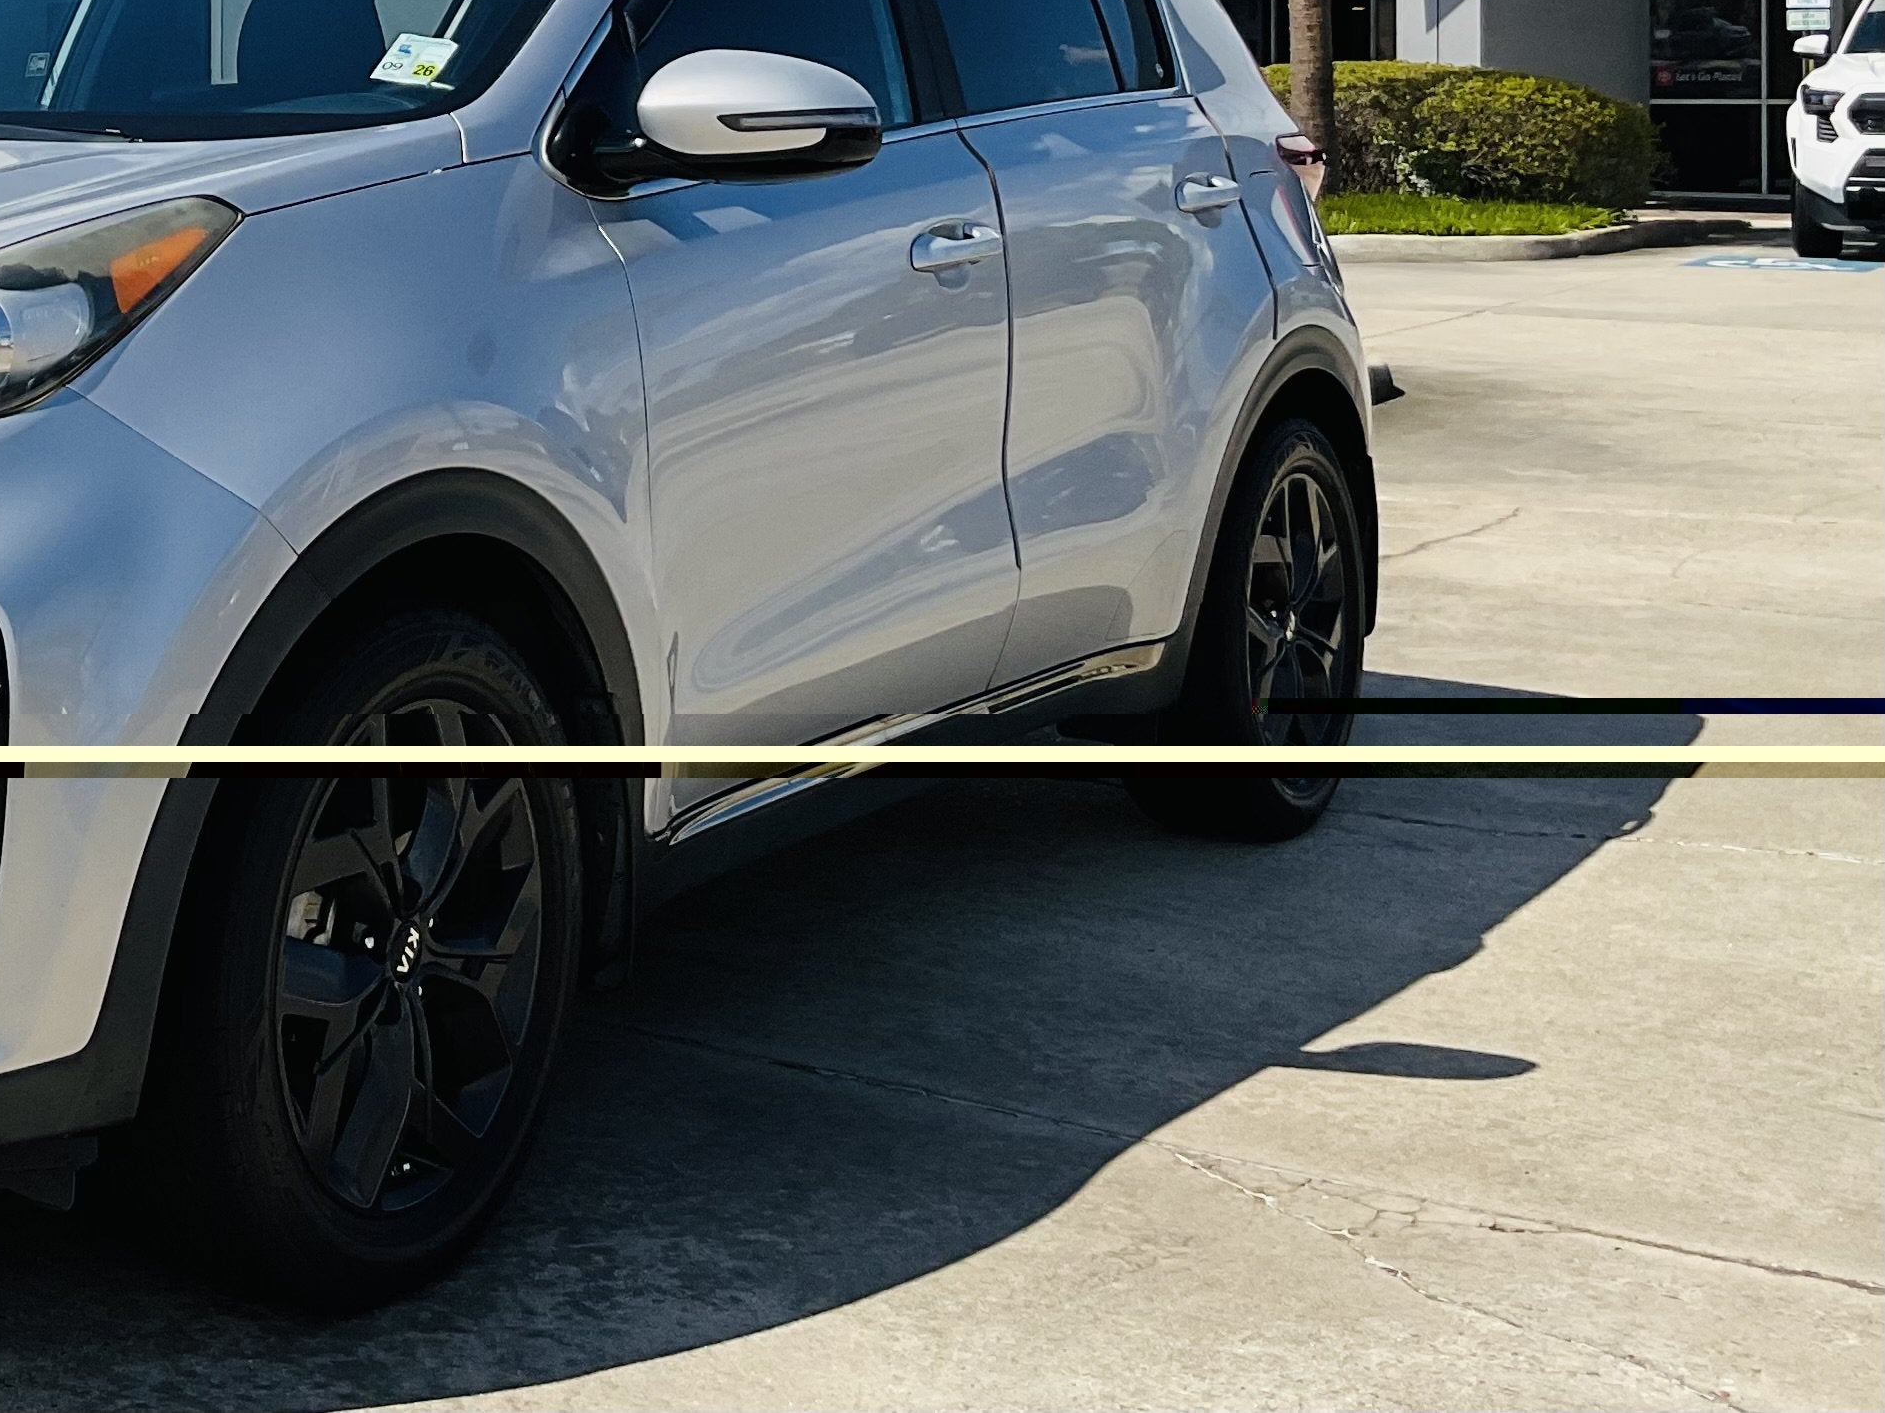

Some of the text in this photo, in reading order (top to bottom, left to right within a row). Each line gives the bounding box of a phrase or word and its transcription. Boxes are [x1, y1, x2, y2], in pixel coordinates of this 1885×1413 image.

[382, 61, 436, 76] 09 26
[396, 927, 420, 973] KIA
